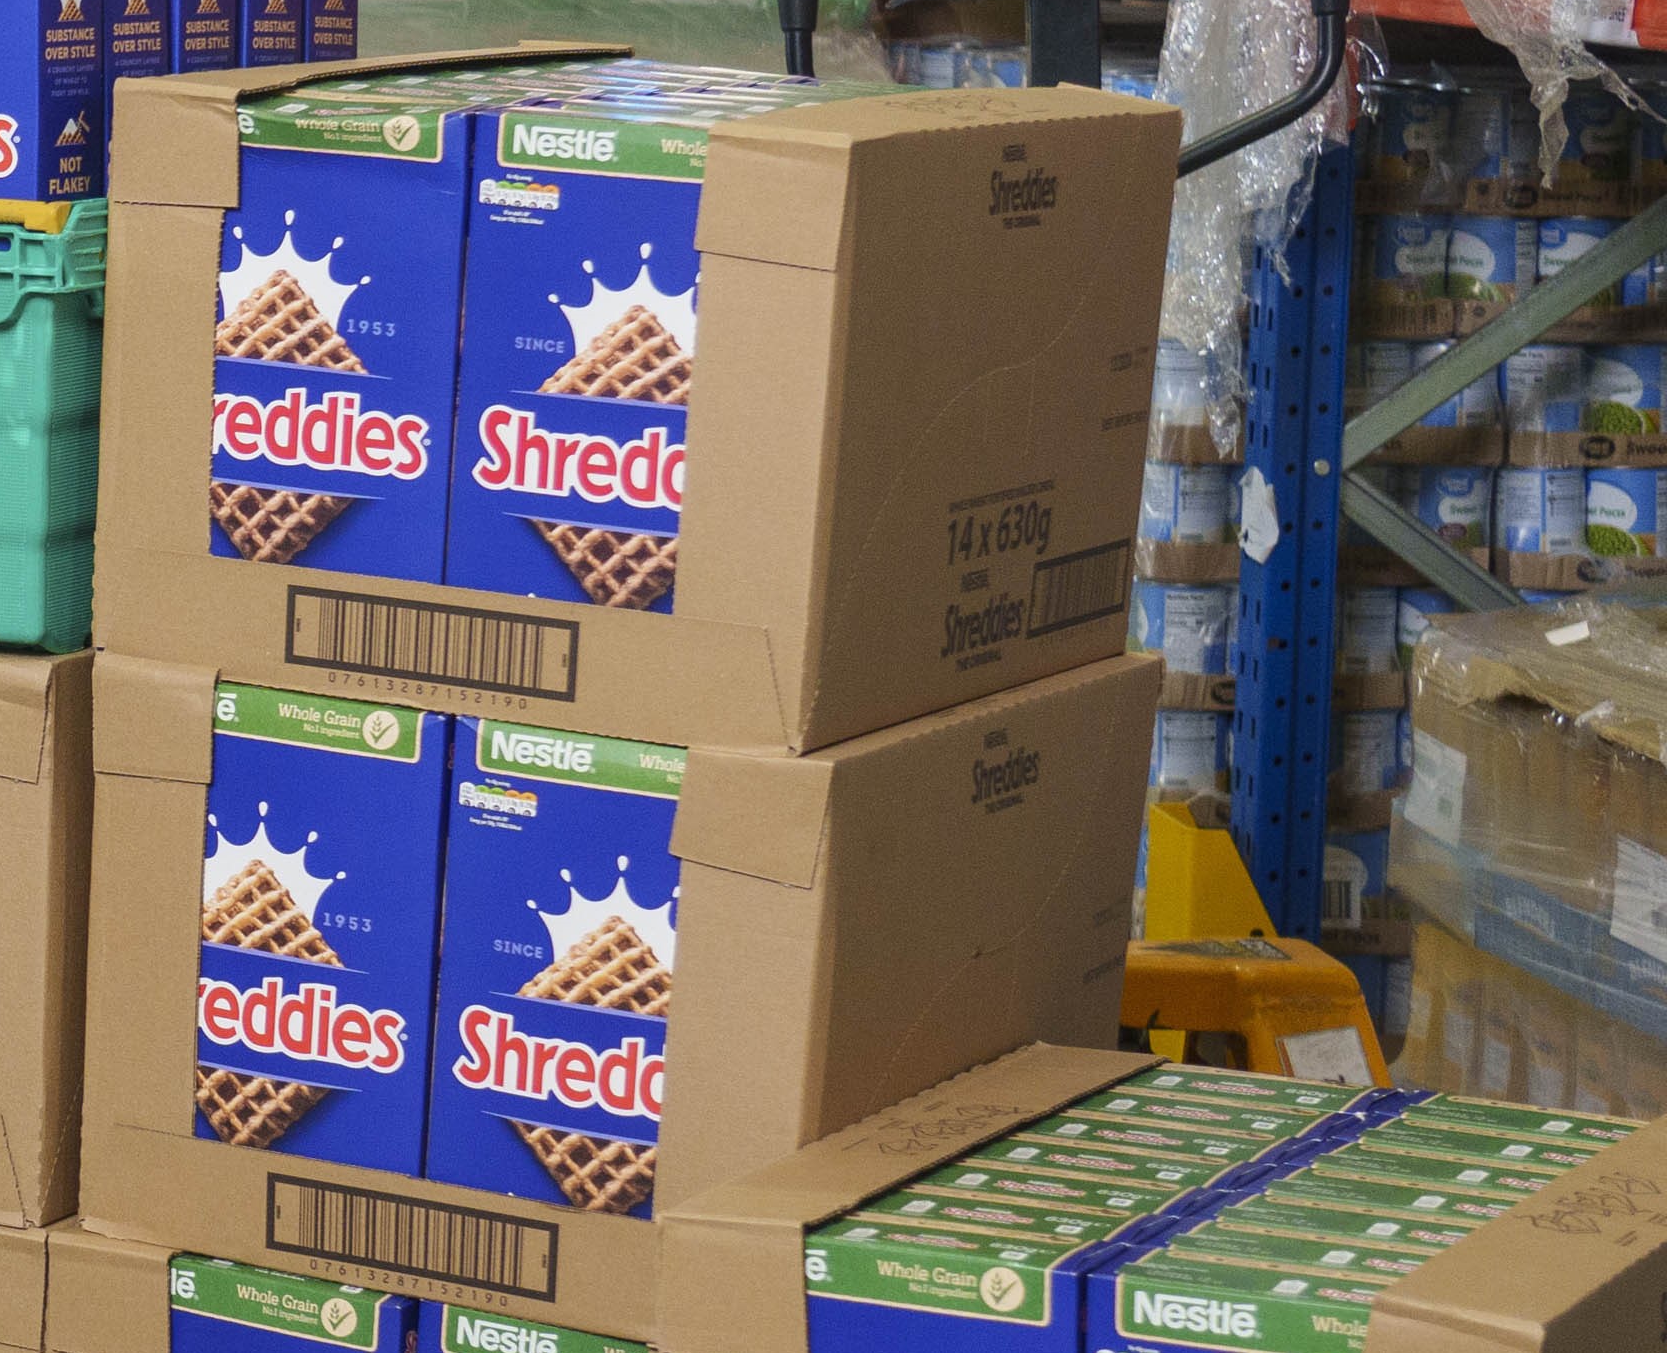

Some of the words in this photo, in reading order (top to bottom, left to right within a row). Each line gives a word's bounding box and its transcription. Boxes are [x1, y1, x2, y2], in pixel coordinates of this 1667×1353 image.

[46, 28, 95, 42] SUBSTANCE
[113, 21, 160, 35] SUBSTANCE
[45, 47, 68, 60] OVER
[71, 45, 95, 58] STYLE
[341, 120, 379, 132] Grain
[512, 124, 617, 163] Nestlé
[60, 157, 82, 173] NOT
[49, 176, 91, 195] FLAKEY
[347, 318, 396, 338] 1953
[514, 336, 565, 355] SINCE
[213, 387, 428, 480] reddies
[997, 501, 1052, 555] 630g
[278, 703, 321, 722] Whole
[324, 710, 361, 728] Grain
[491, 730, 594, 774] Nestlé
[322, 912, 372, 933] 1953
[493, 938, 544, 960] SINCE
[877, 1259, 928, 1280] Whole
[932, 1265, 978, 1286] Grain
[236, 1284, 279, 1308] Whole
[281, 1292, 319, 1314] Grain
[1133, 1290, 1259, 1338] Nestlé
